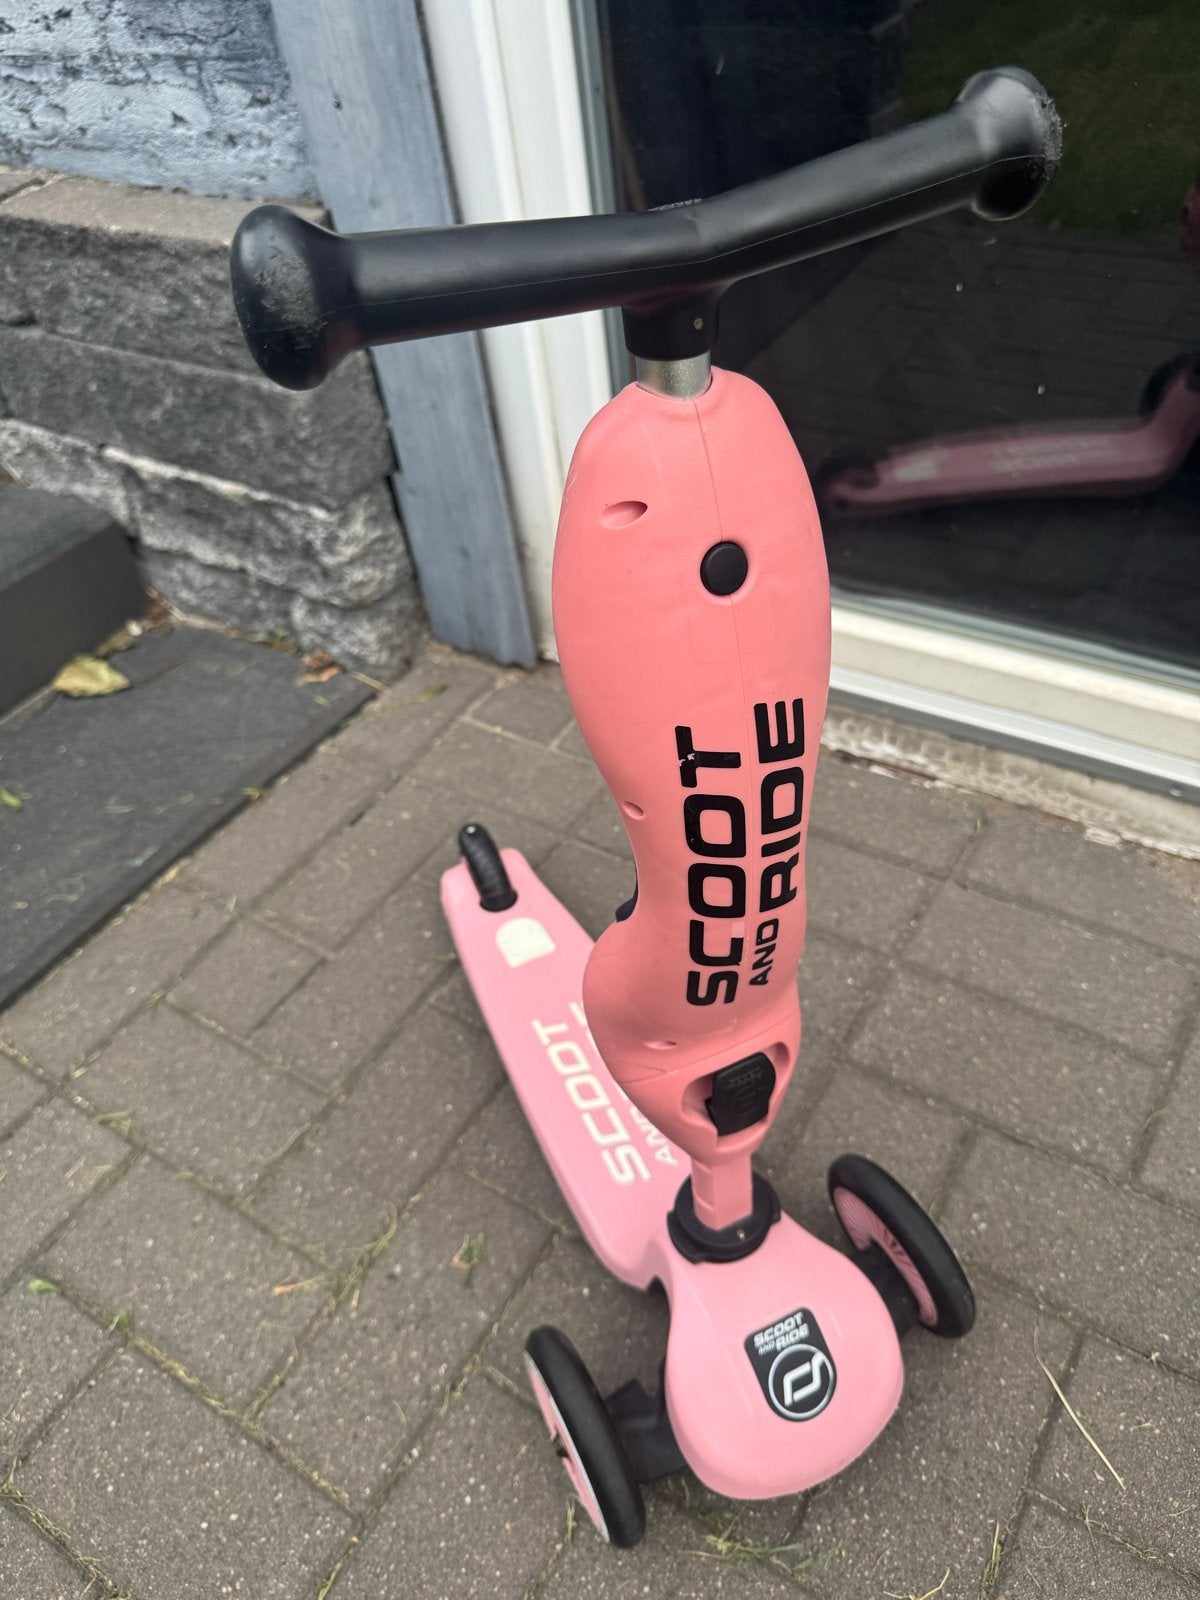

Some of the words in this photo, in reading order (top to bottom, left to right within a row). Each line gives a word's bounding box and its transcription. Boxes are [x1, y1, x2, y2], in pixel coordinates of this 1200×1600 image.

[753, 697, 805, 912] RIDE
[674, 725, 746, 1006] SCOOT
[748, 918, 779, 986] AND
[530, 1018, 651, 1184] SCOOT
[754, 1311, 803, 1348] SCOOT
[775, 1322, 809, 1351] RIDE
